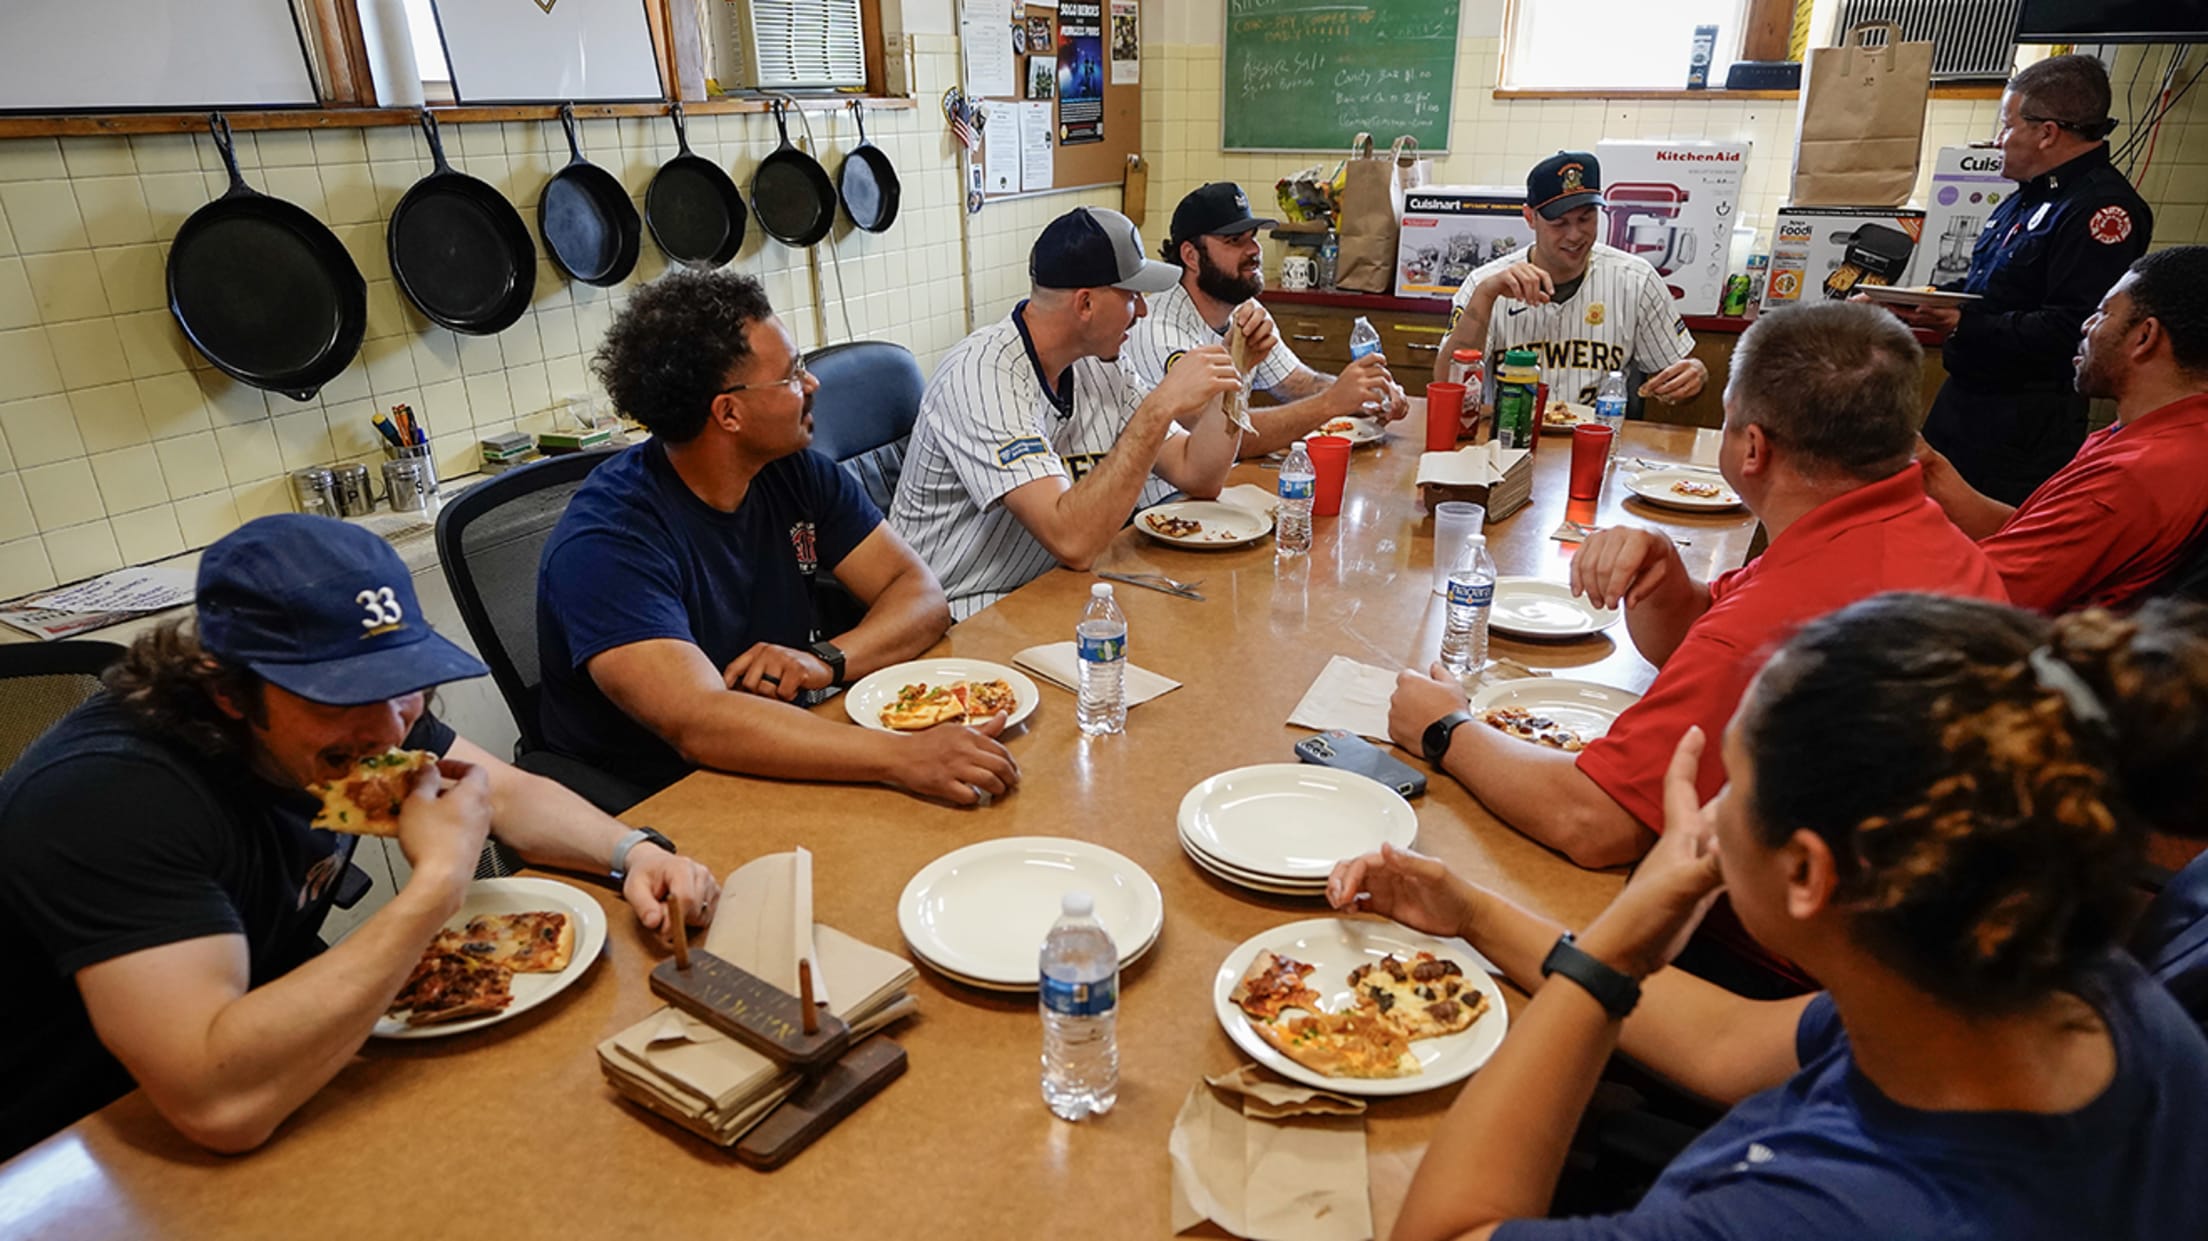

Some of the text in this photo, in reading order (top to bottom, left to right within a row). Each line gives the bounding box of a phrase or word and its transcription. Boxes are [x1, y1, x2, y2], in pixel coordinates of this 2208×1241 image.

[1656, 151, 1740, 162] KitchenAid
[1410, 198, 1461, 211] Cuisinart
[1780, 224, 1813, 236] Foodi
[416, 480, 424, 494] S
[347, 489, 359, 504] P
[355, 586, 402, 628] 33
